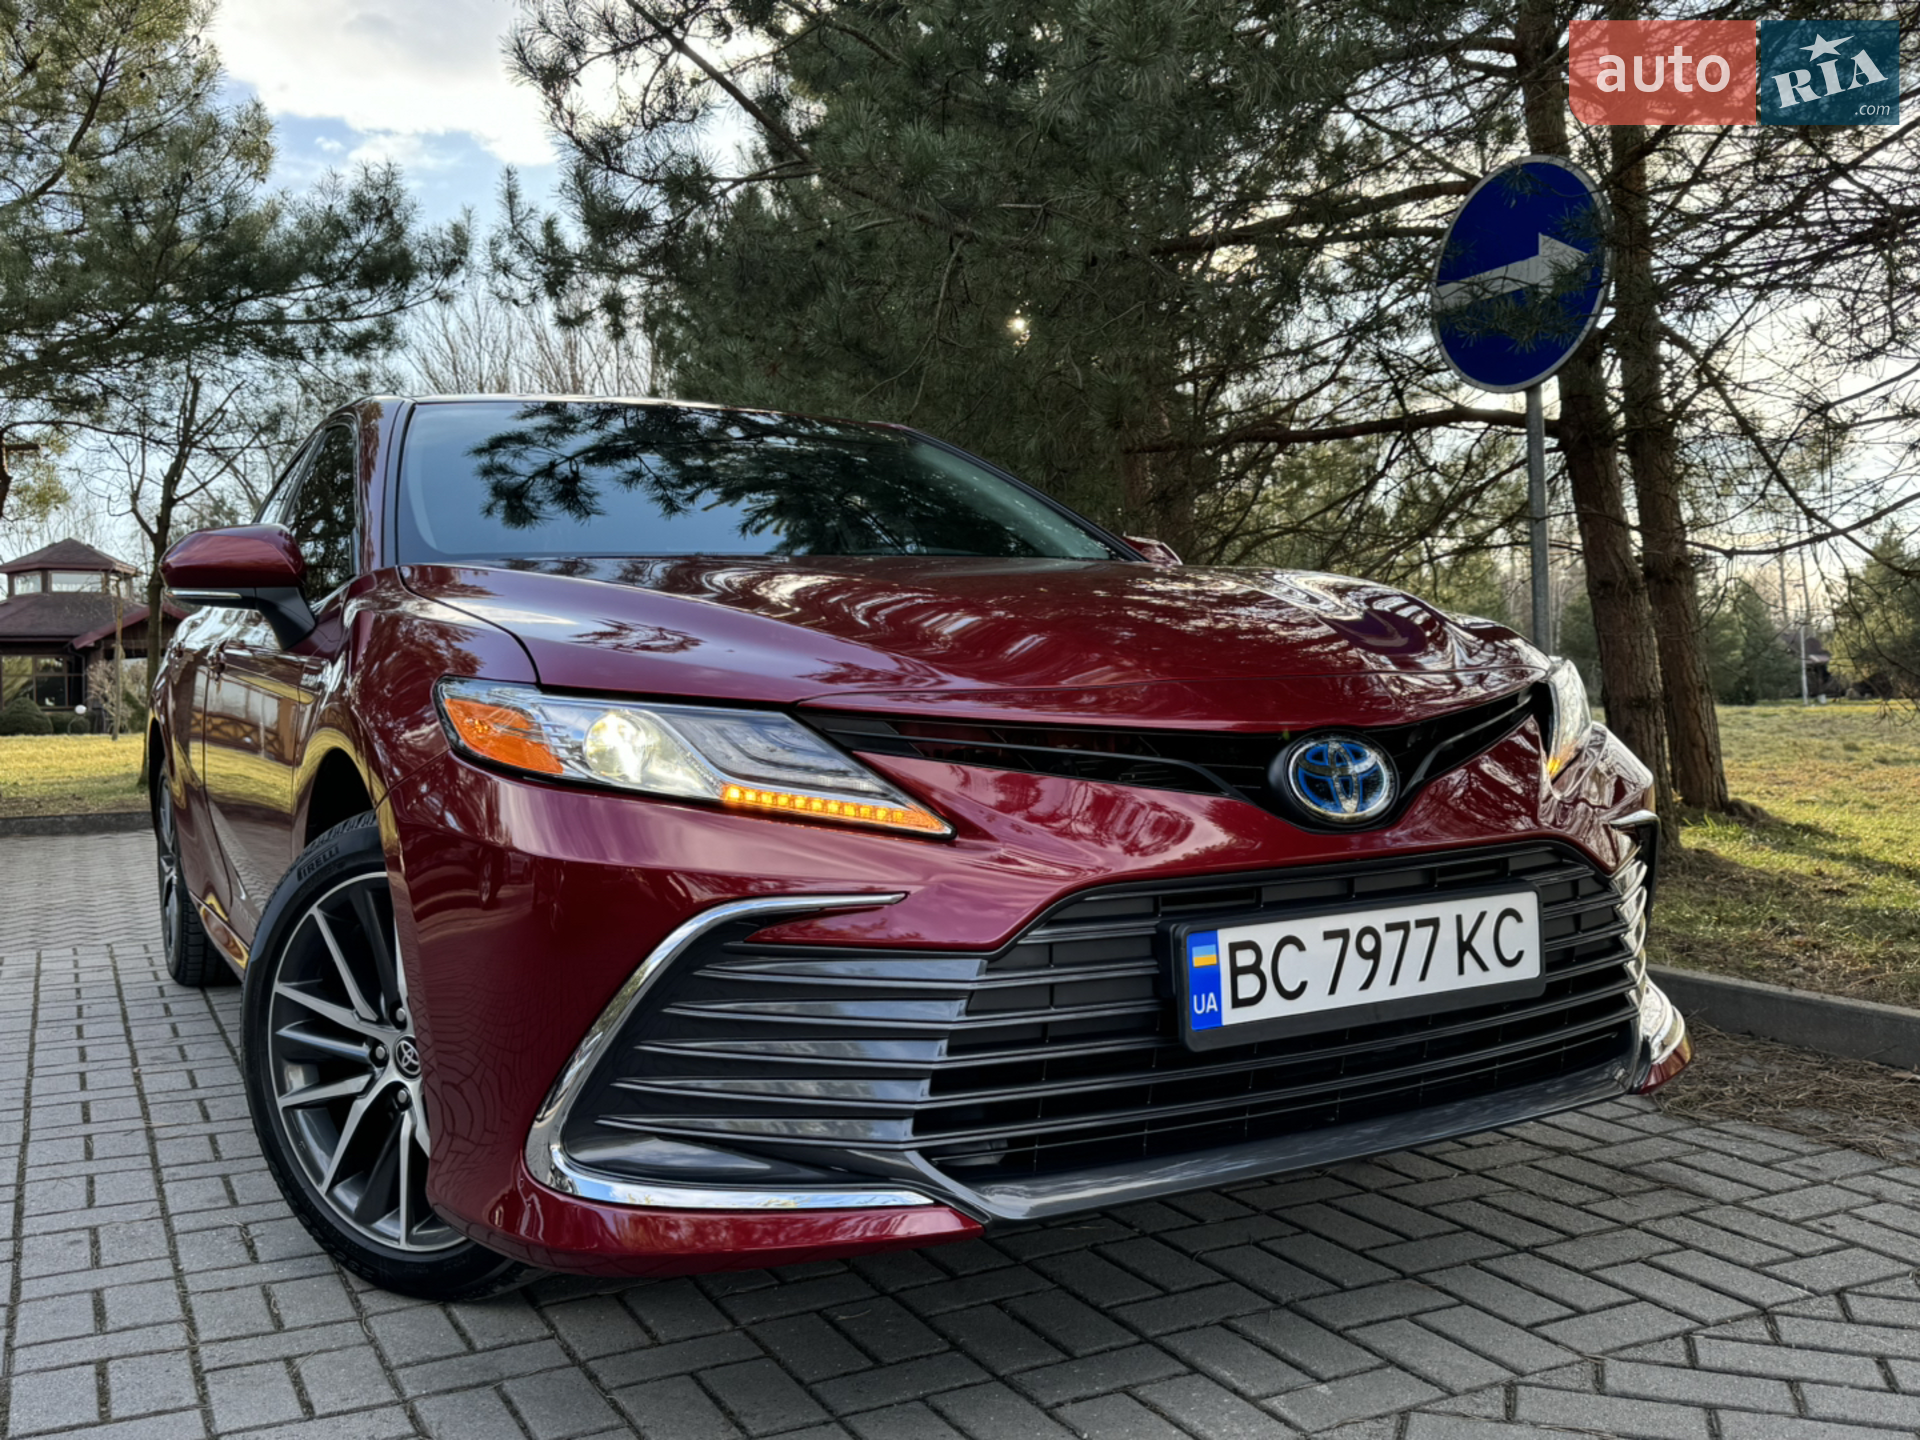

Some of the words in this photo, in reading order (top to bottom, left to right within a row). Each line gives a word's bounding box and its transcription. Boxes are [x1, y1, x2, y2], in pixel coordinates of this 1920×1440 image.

[297, 843, 340, 882] PIRELLI
[1228, 934, 1308, 1009] BC
[1323, 916, 1441, 996] 7977
[1455, 907, 1525, 976] KC
[1193, 991, 1218, 1015] UA
